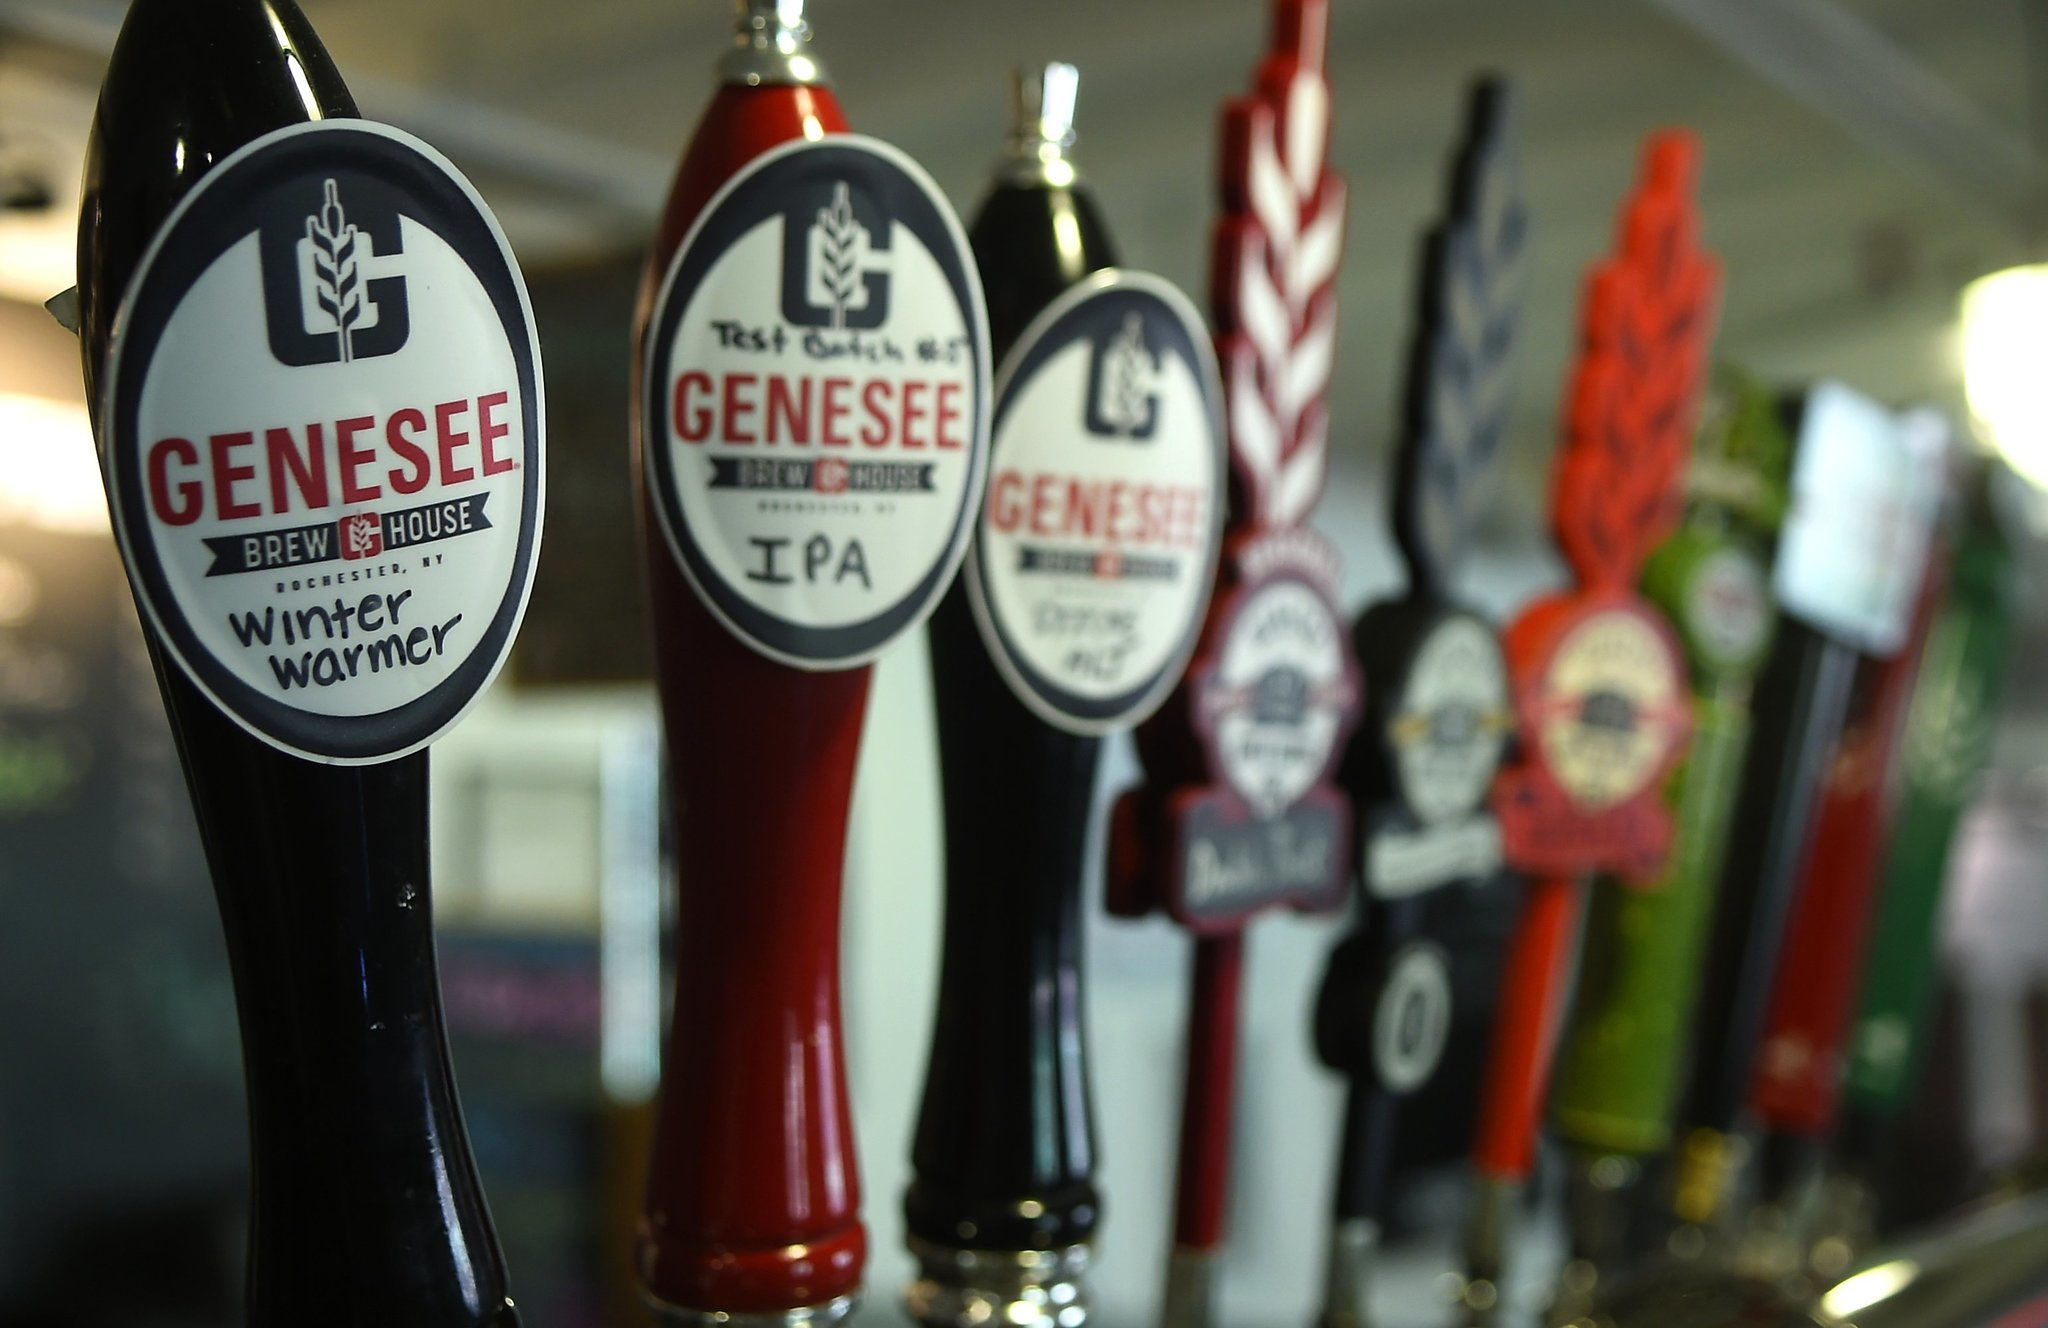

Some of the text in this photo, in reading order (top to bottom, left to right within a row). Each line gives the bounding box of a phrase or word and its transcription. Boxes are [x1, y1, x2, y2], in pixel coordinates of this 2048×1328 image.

[710, 320, 786, 355] Test
[673, 371, 968, 451] GENESEE
[147, 391, 513, 527] GENESEE
[741, 460, 808, 489] BREW
[854, 464, 922, 492] HOUSE
[243, 527, 330, 569] BREW
[390, 501, 473, 546] HOUSE
[989, 469, 1204, 550] GENESEE
[277, 553, 444, 593] ROCHESTER, NY
[747, 533, 873, 591] IPA
[269, 613, 463, 690] warmer
